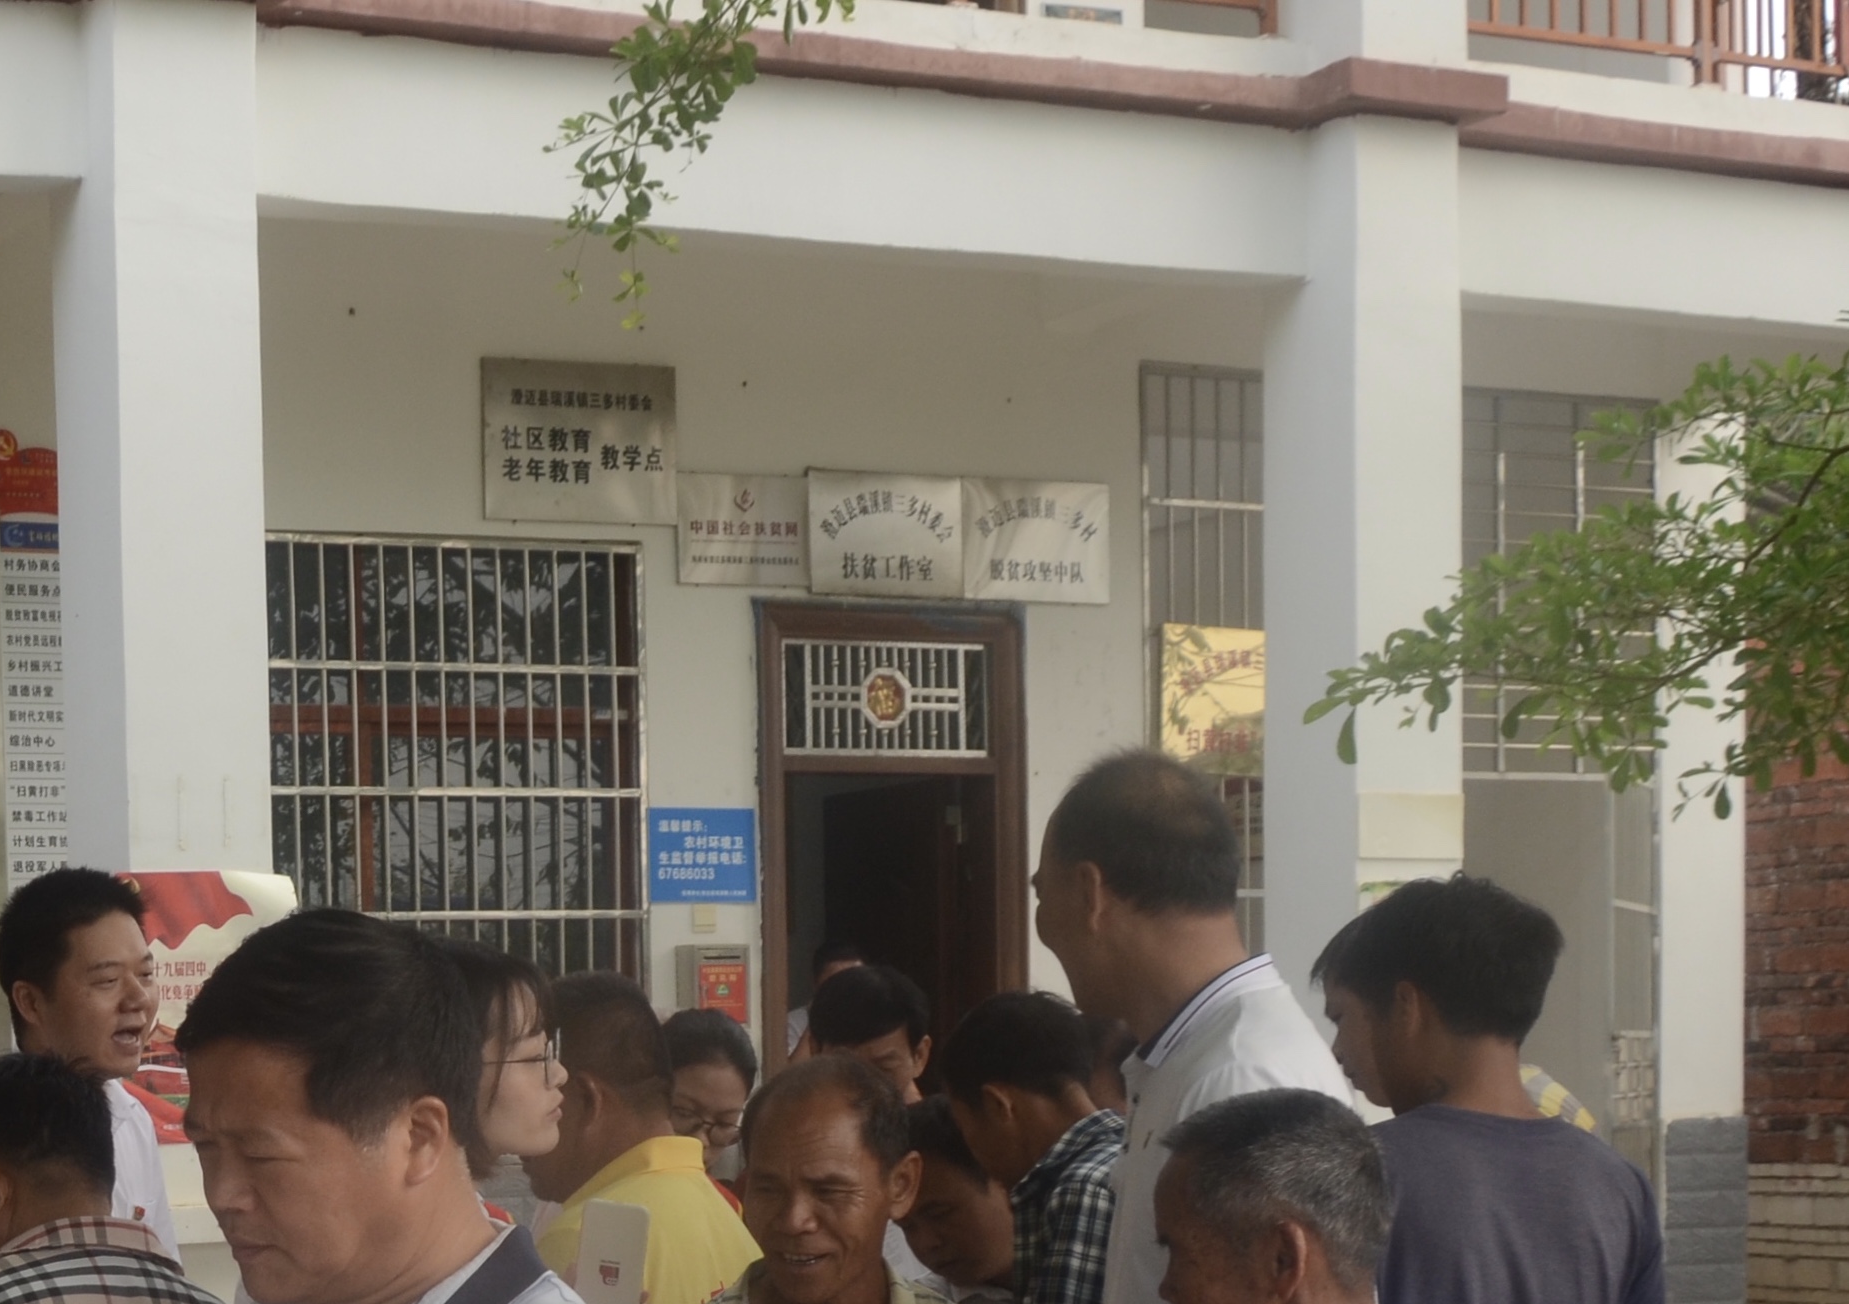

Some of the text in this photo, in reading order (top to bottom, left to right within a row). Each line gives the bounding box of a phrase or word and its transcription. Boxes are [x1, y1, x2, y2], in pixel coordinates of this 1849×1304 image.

[502, 424, 592, 453] 社区教育
[502, 456, 592, 485] 老年教育
[600, 444, 664, 472] 教学点
[841, 552, 934, 582] 扶贫工作室
[989, 558, 1085, 584] 脱贫攻坚中队
[8, 684, 54, 698] 道德讲堂
[9, 735, 56, 748] 综治中心
[10, 760, 66, 773] 扫黑除恶专项
[684, 835, 745, 849] 农村环境卫
